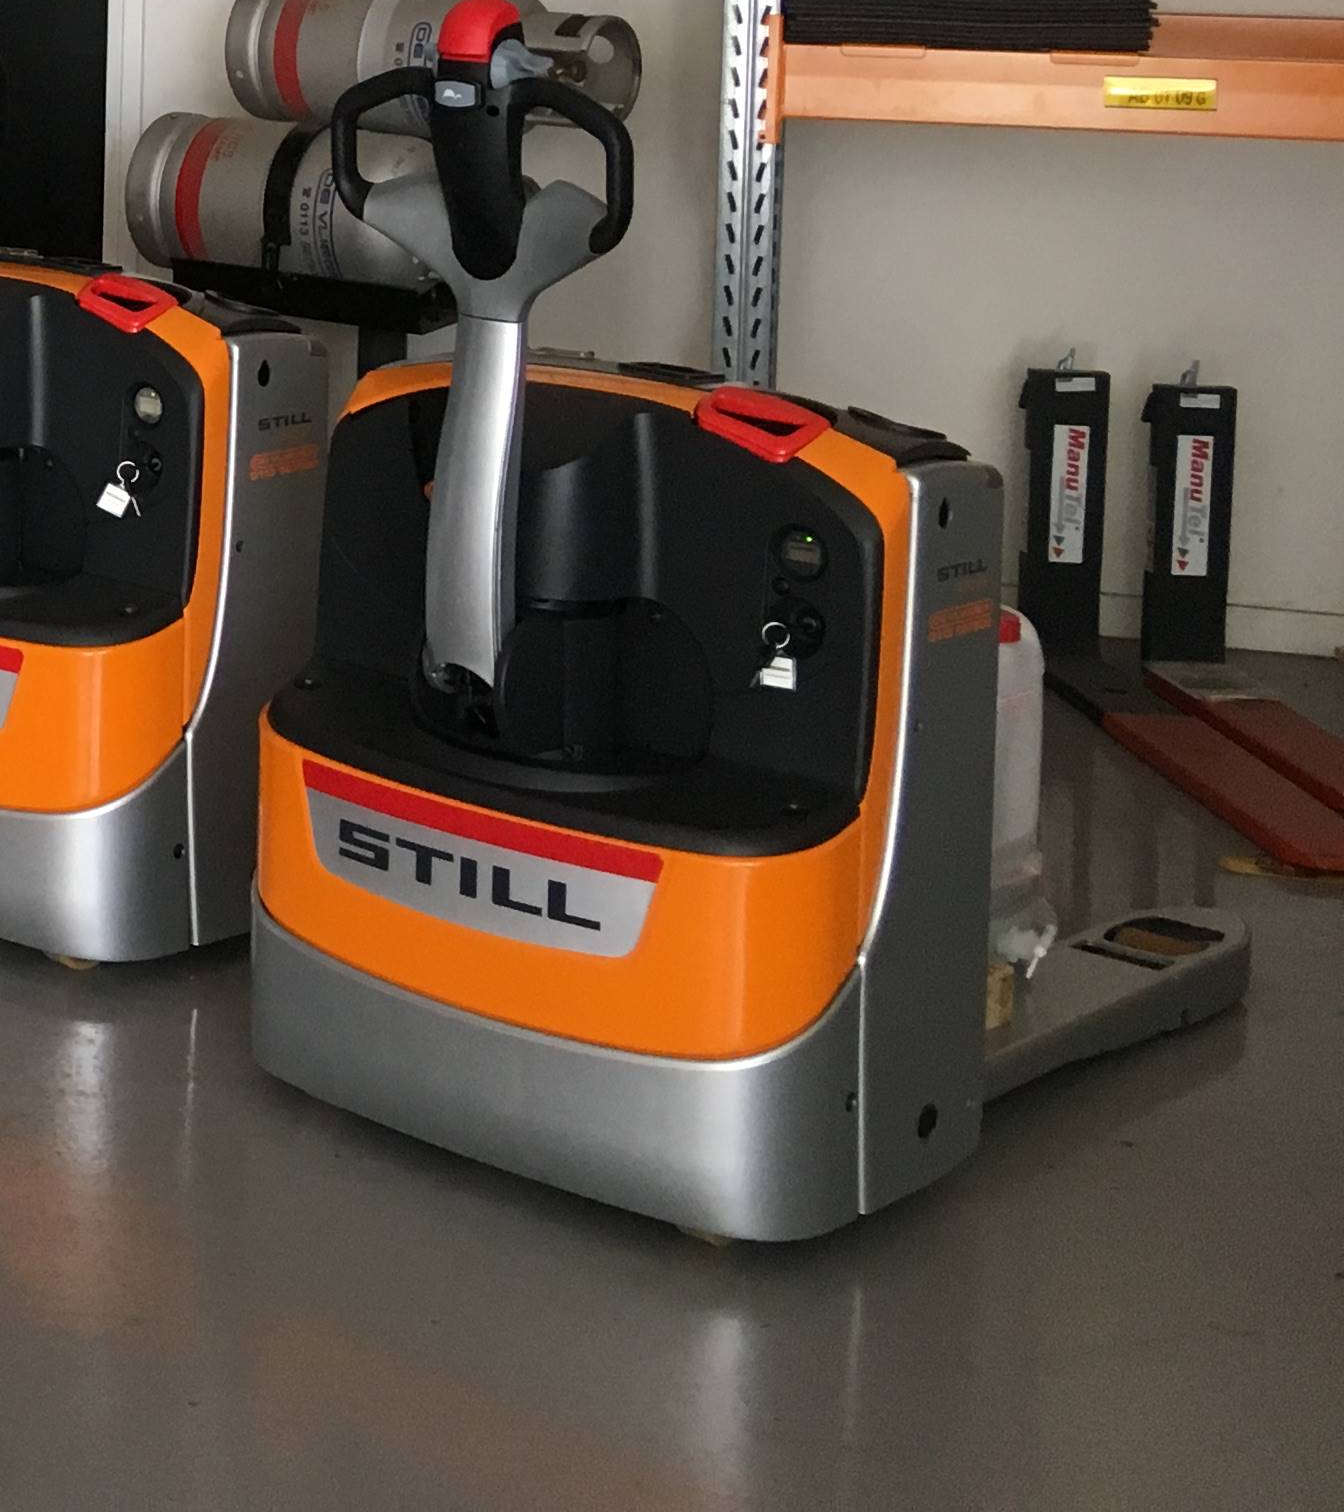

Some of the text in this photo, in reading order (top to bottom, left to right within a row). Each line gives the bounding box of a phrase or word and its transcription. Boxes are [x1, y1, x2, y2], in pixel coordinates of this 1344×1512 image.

[257, 412, 312, 431] STILL
[937, 558, 988, 582] STILL
[339, 818, 601, 931] STILL
